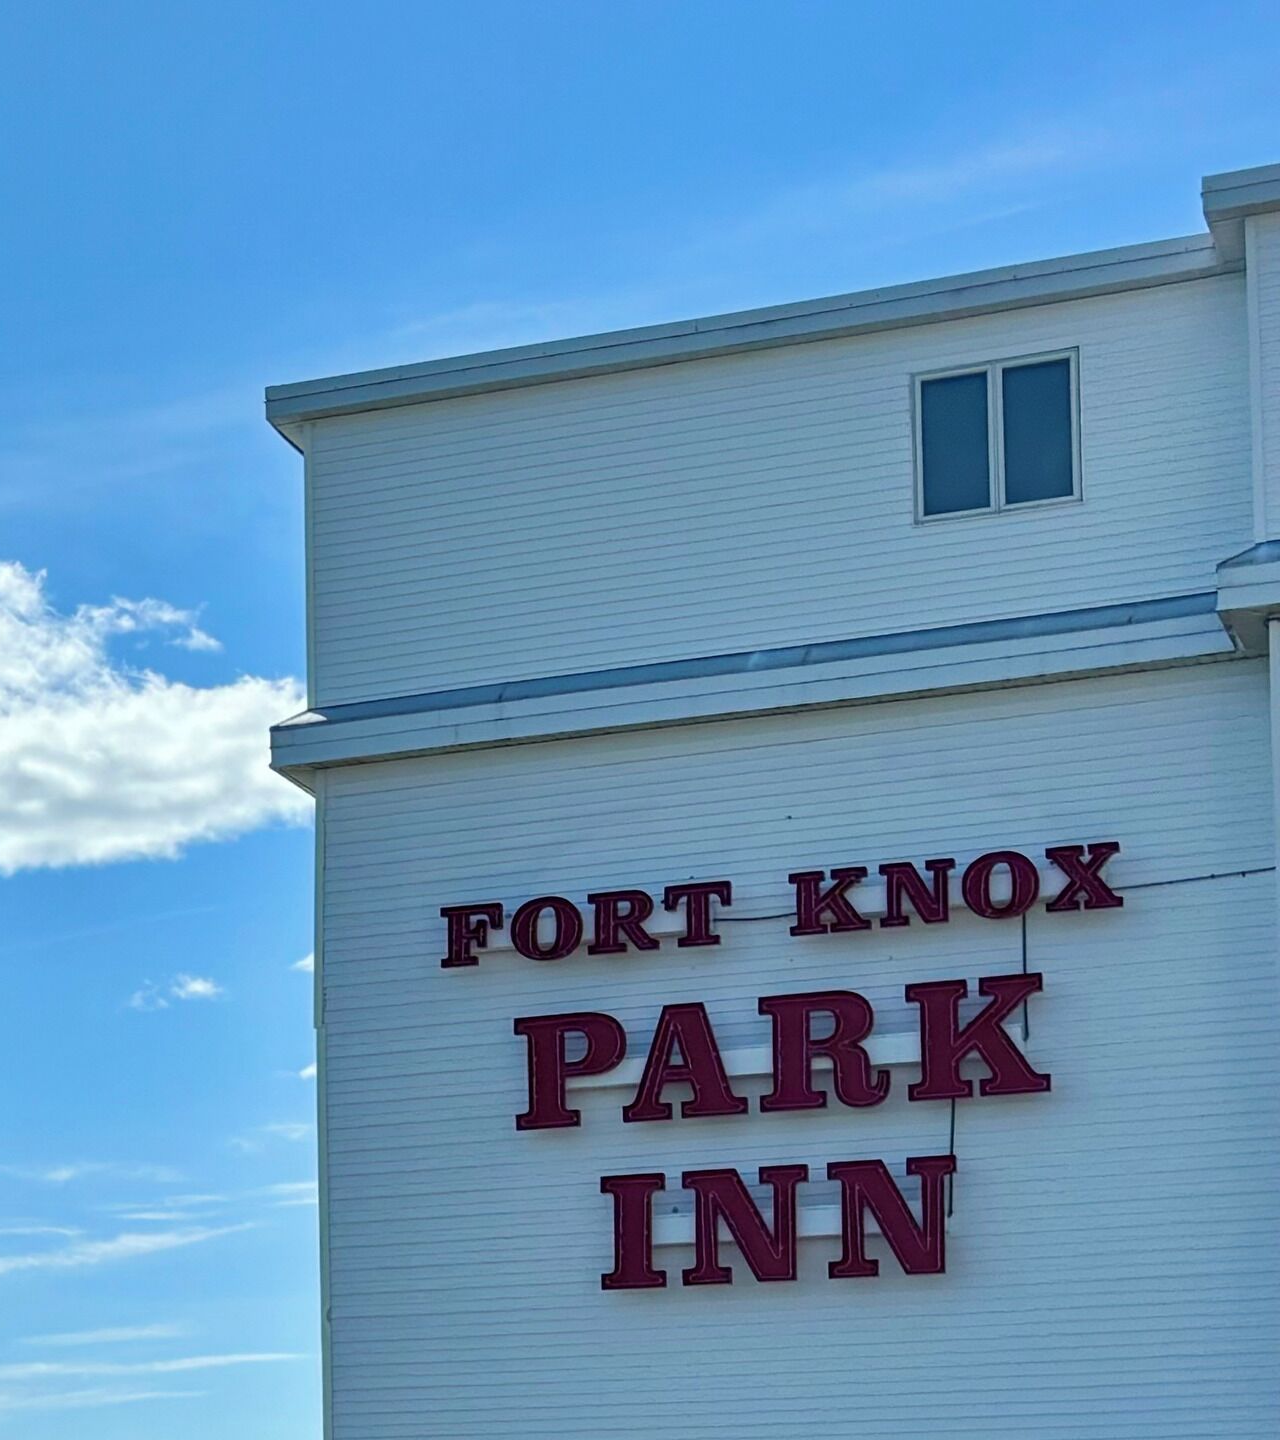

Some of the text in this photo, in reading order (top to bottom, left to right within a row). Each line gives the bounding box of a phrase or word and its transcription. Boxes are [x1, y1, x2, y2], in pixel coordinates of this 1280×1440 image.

[440, 841, 1125, 968] FORT KNOX
[514, 972, 1052, 1131] PARK
[600, 1154, 957, 1291] INN
